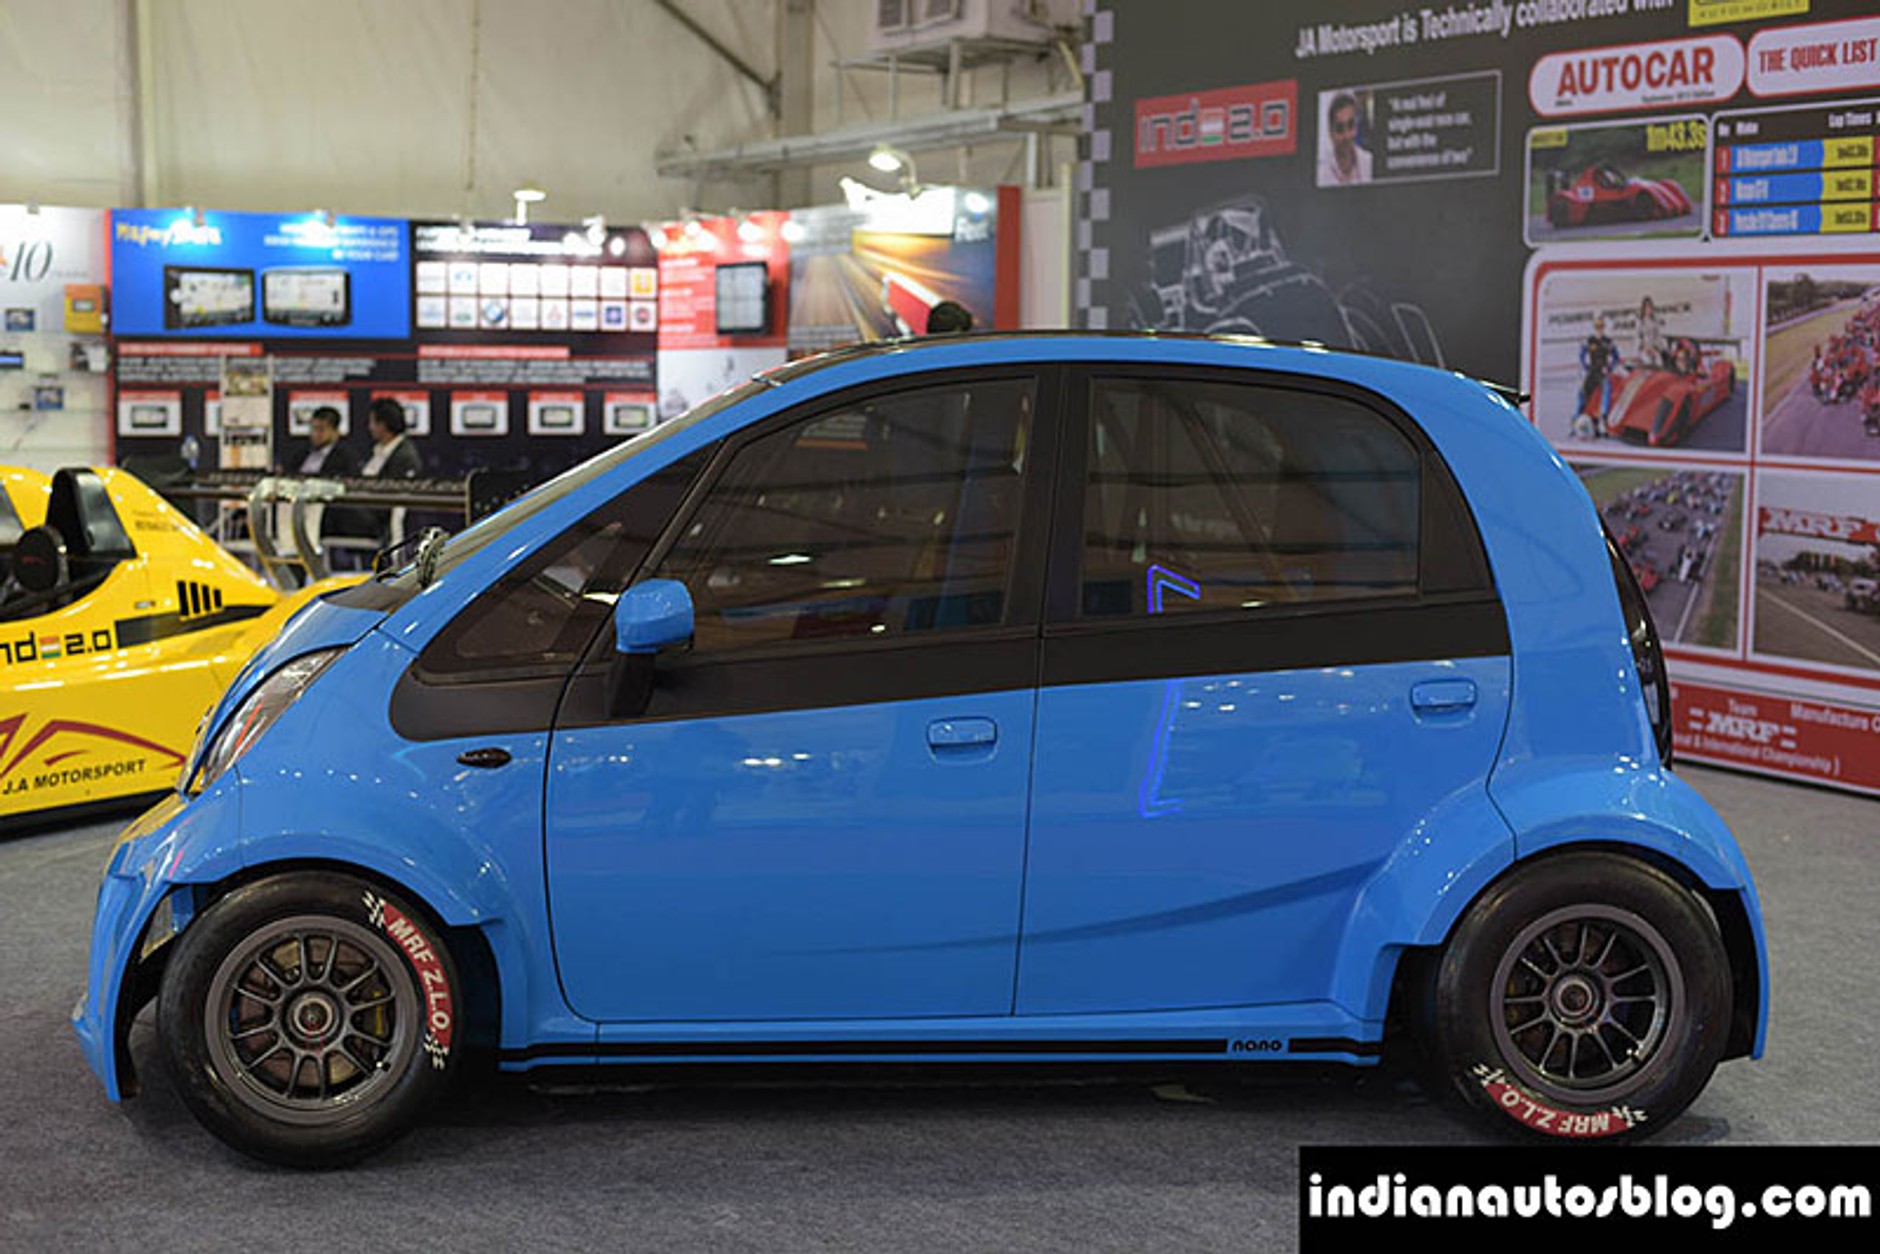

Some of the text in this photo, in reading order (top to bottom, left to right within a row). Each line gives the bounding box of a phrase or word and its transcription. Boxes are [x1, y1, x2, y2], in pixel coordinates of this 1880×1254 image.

[1318, 15, 1400, 55] Motorsport
[1402, 13, 1417, 42] is
[1420, 0, 1512, 39] Technically
[1557, 47, 1714, 97] AUTOCAR
[1758, 38, 1878, 74] THE QUICK LIST
[1706, 711, 1780, 743] MRF
[34, 758, 146, 788] MOTORSPORT
[388, 917, 435, 963] MRF
[1232, 1040, 1282, 1053] nano
[1558, 1113, 1610, 1134] MRF
